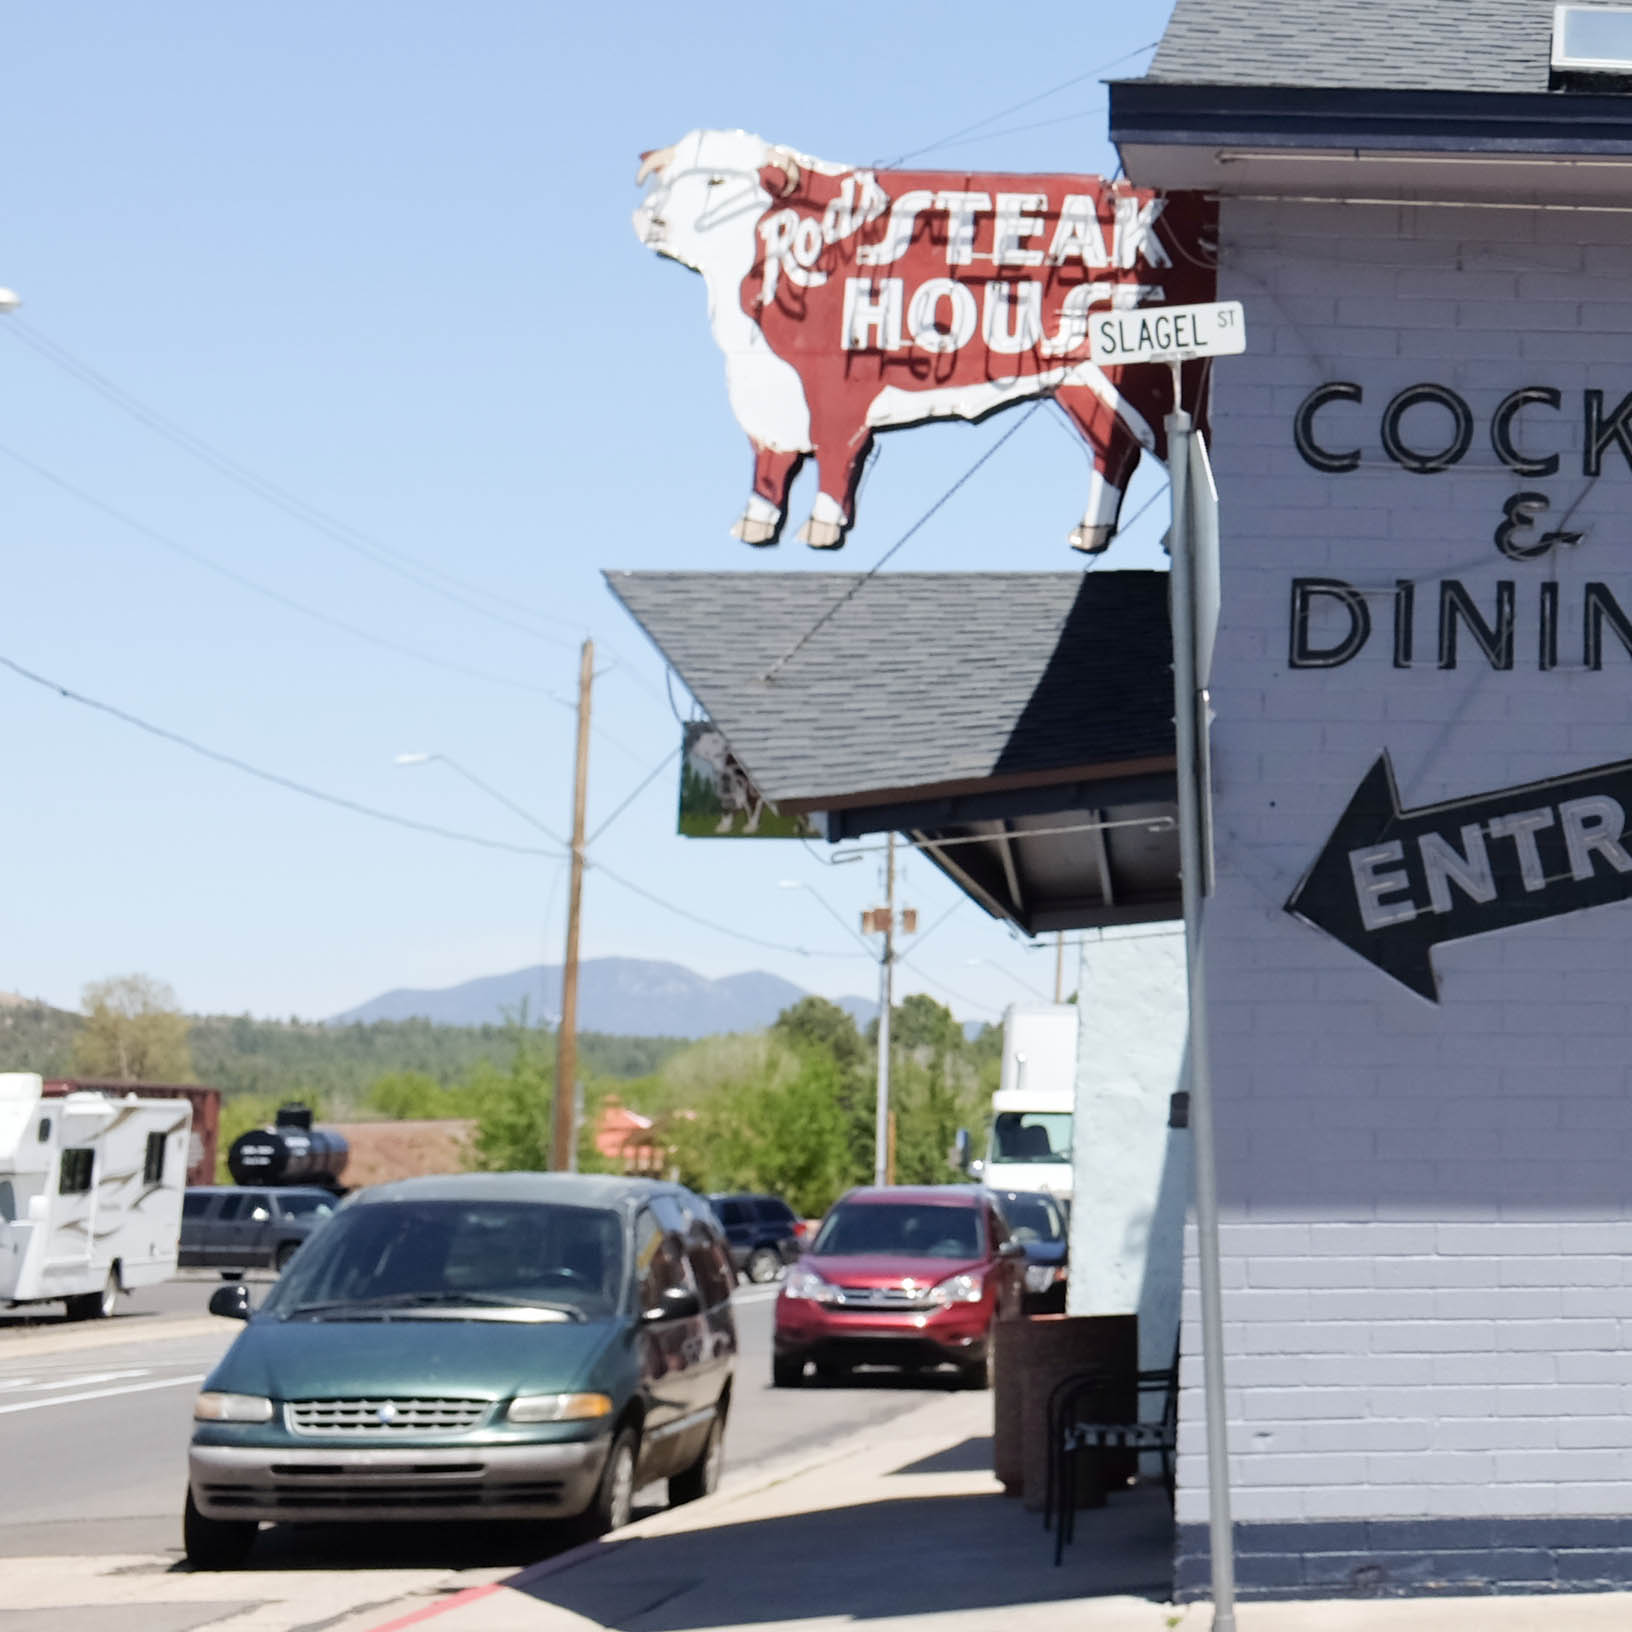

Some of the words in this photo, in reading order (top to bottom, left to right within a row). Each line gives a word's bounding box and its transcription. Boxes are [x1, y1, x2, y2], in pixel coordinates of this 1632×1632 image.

[757, 169, 891, 306] Rod's
[857, 189, 1173, 269] STEAK
[1100, 313, 1208, 354] SLAGEL
[1217, 310, 1236, 328] ST
[1493, 492, 1584, 562] &
